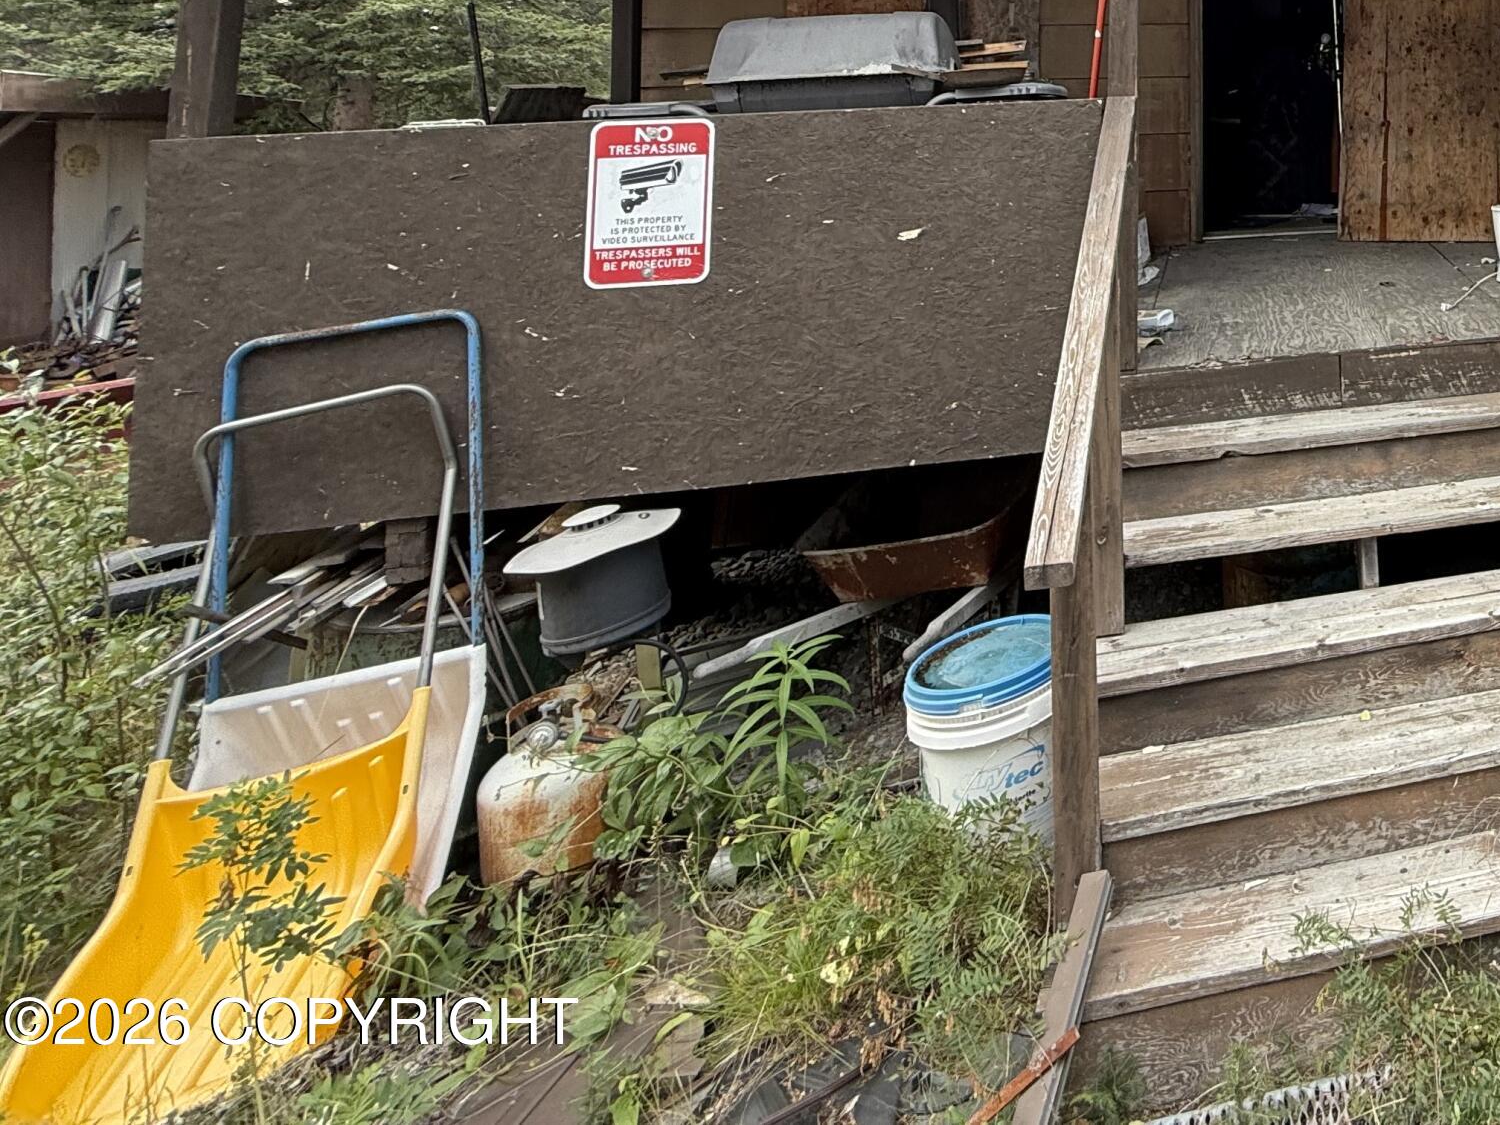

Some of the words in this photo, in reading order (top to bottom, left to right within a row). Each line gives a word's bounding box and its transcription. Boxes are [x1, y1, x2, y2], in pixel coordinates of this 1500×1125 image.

[634, 126, 673, 143] NO
[608, 142, 697, 156] TRESPASSING
[615, 217, 635, 226] THIS
[637, 215, 683, 225] PROPERTY
[610, 227, 620, 235] IS
[622, 225, 672, 235] PROTECTED
[674, 224, 687, 232] BY
[601, 236, 628, 245] VIDEO
[630, 233, 695, 243] SURVEILLANCE
[594, 247, 673, 261] TRESPASSERS
[675, 246, 701, 257] WILL
[602, 261, 618, 272] BE
[620, 258, 692, 271] PROSECUTED
